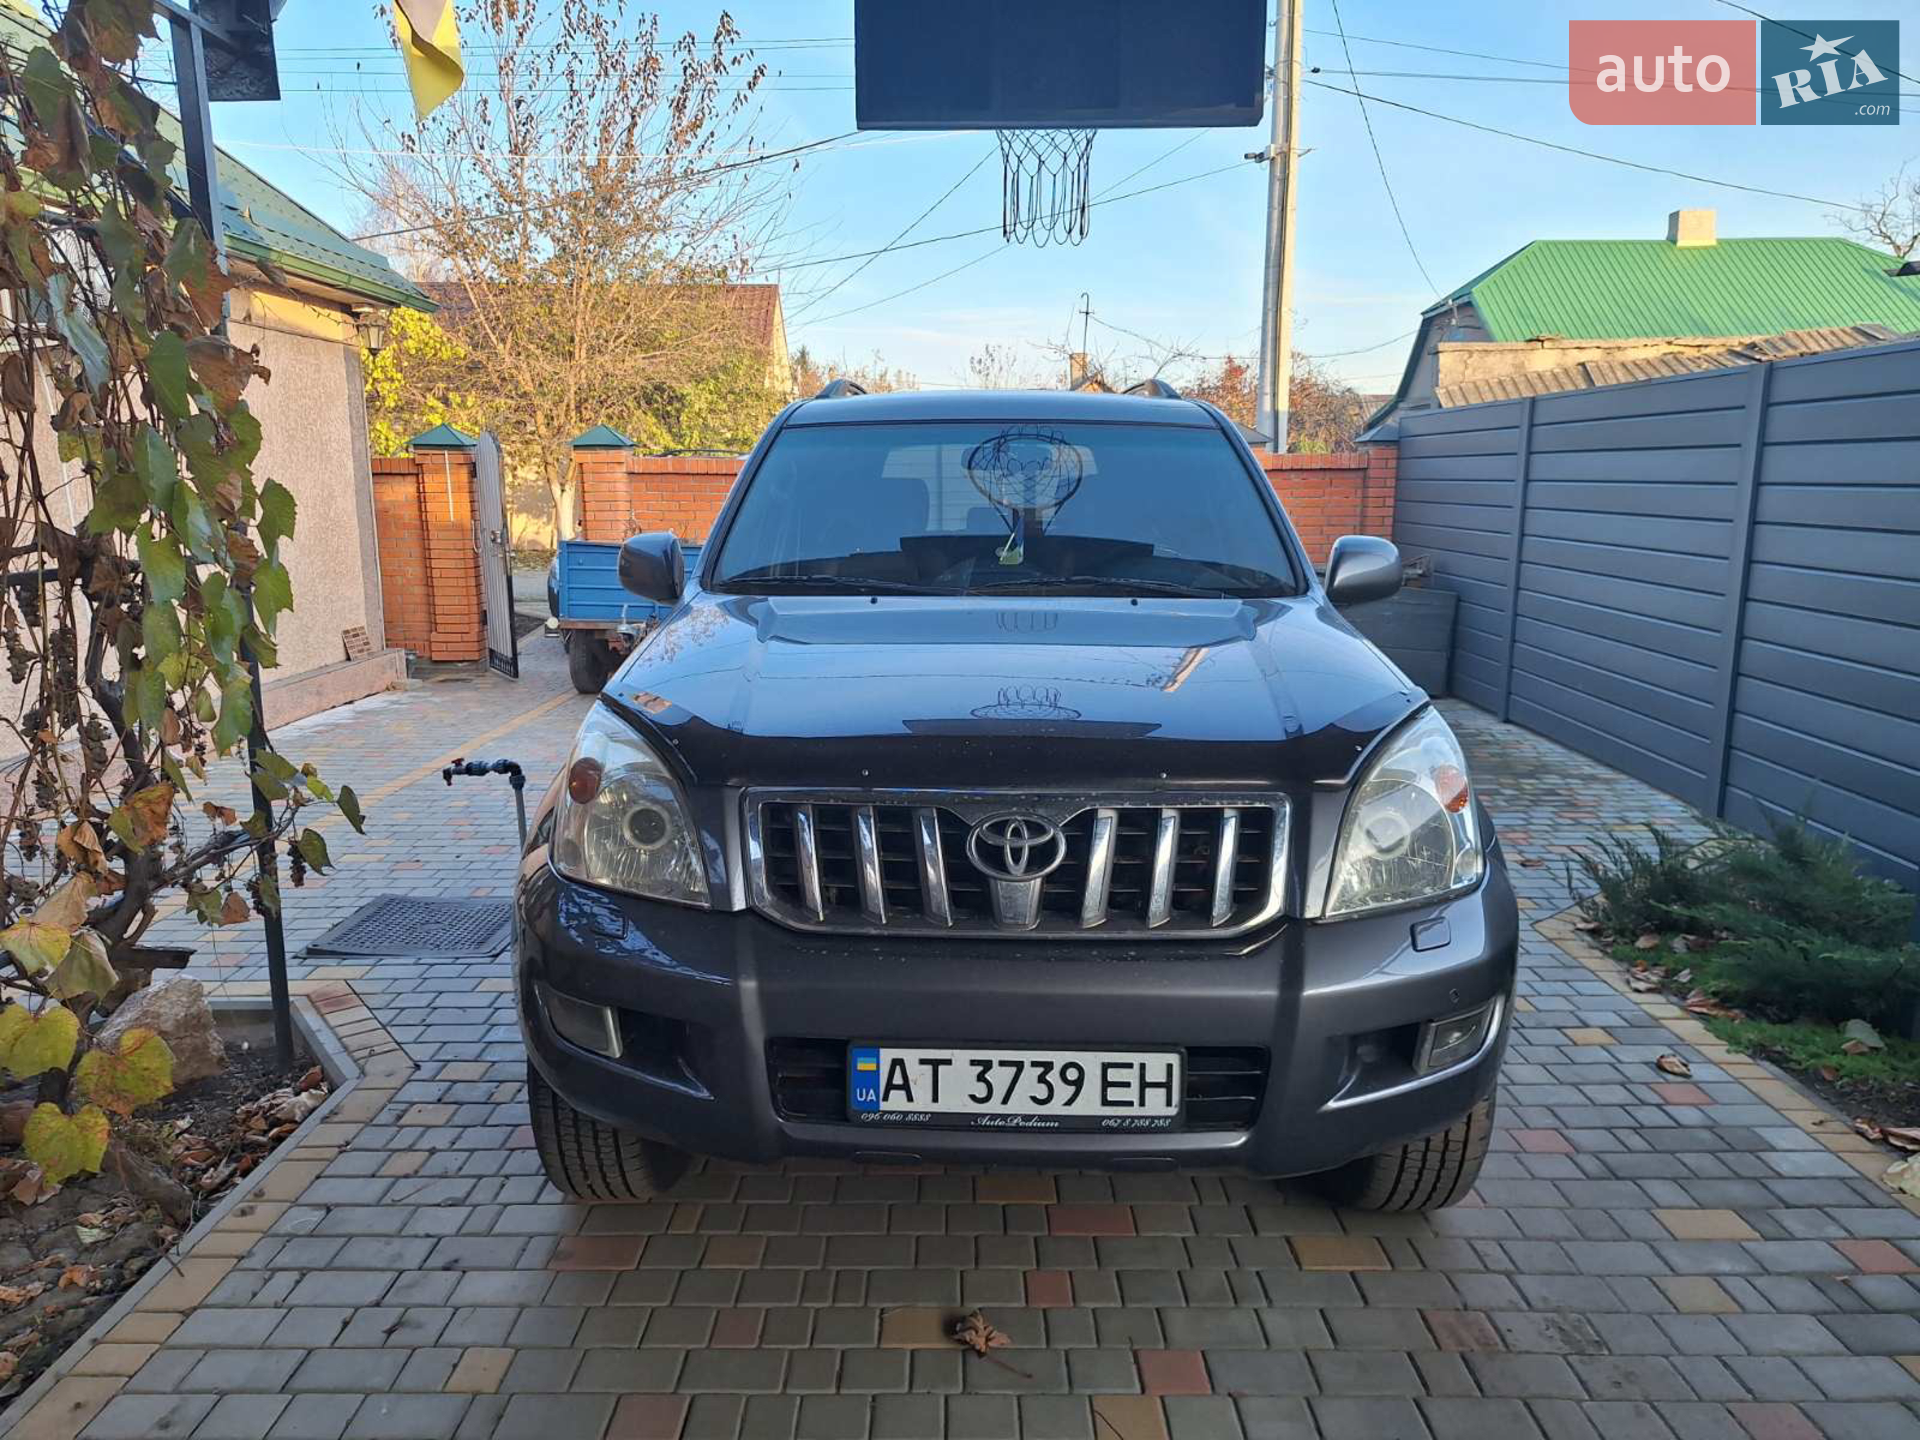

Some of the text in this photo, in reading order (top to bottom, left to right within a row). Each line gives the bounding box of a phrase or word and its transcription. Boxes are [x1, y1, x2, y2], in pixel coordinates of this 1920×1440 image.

[882, 1058, 1174, 1108] AT 3739 EH
[856, 1088, 877, 1103] UA
[861, 1112, 883, 1122] 096
